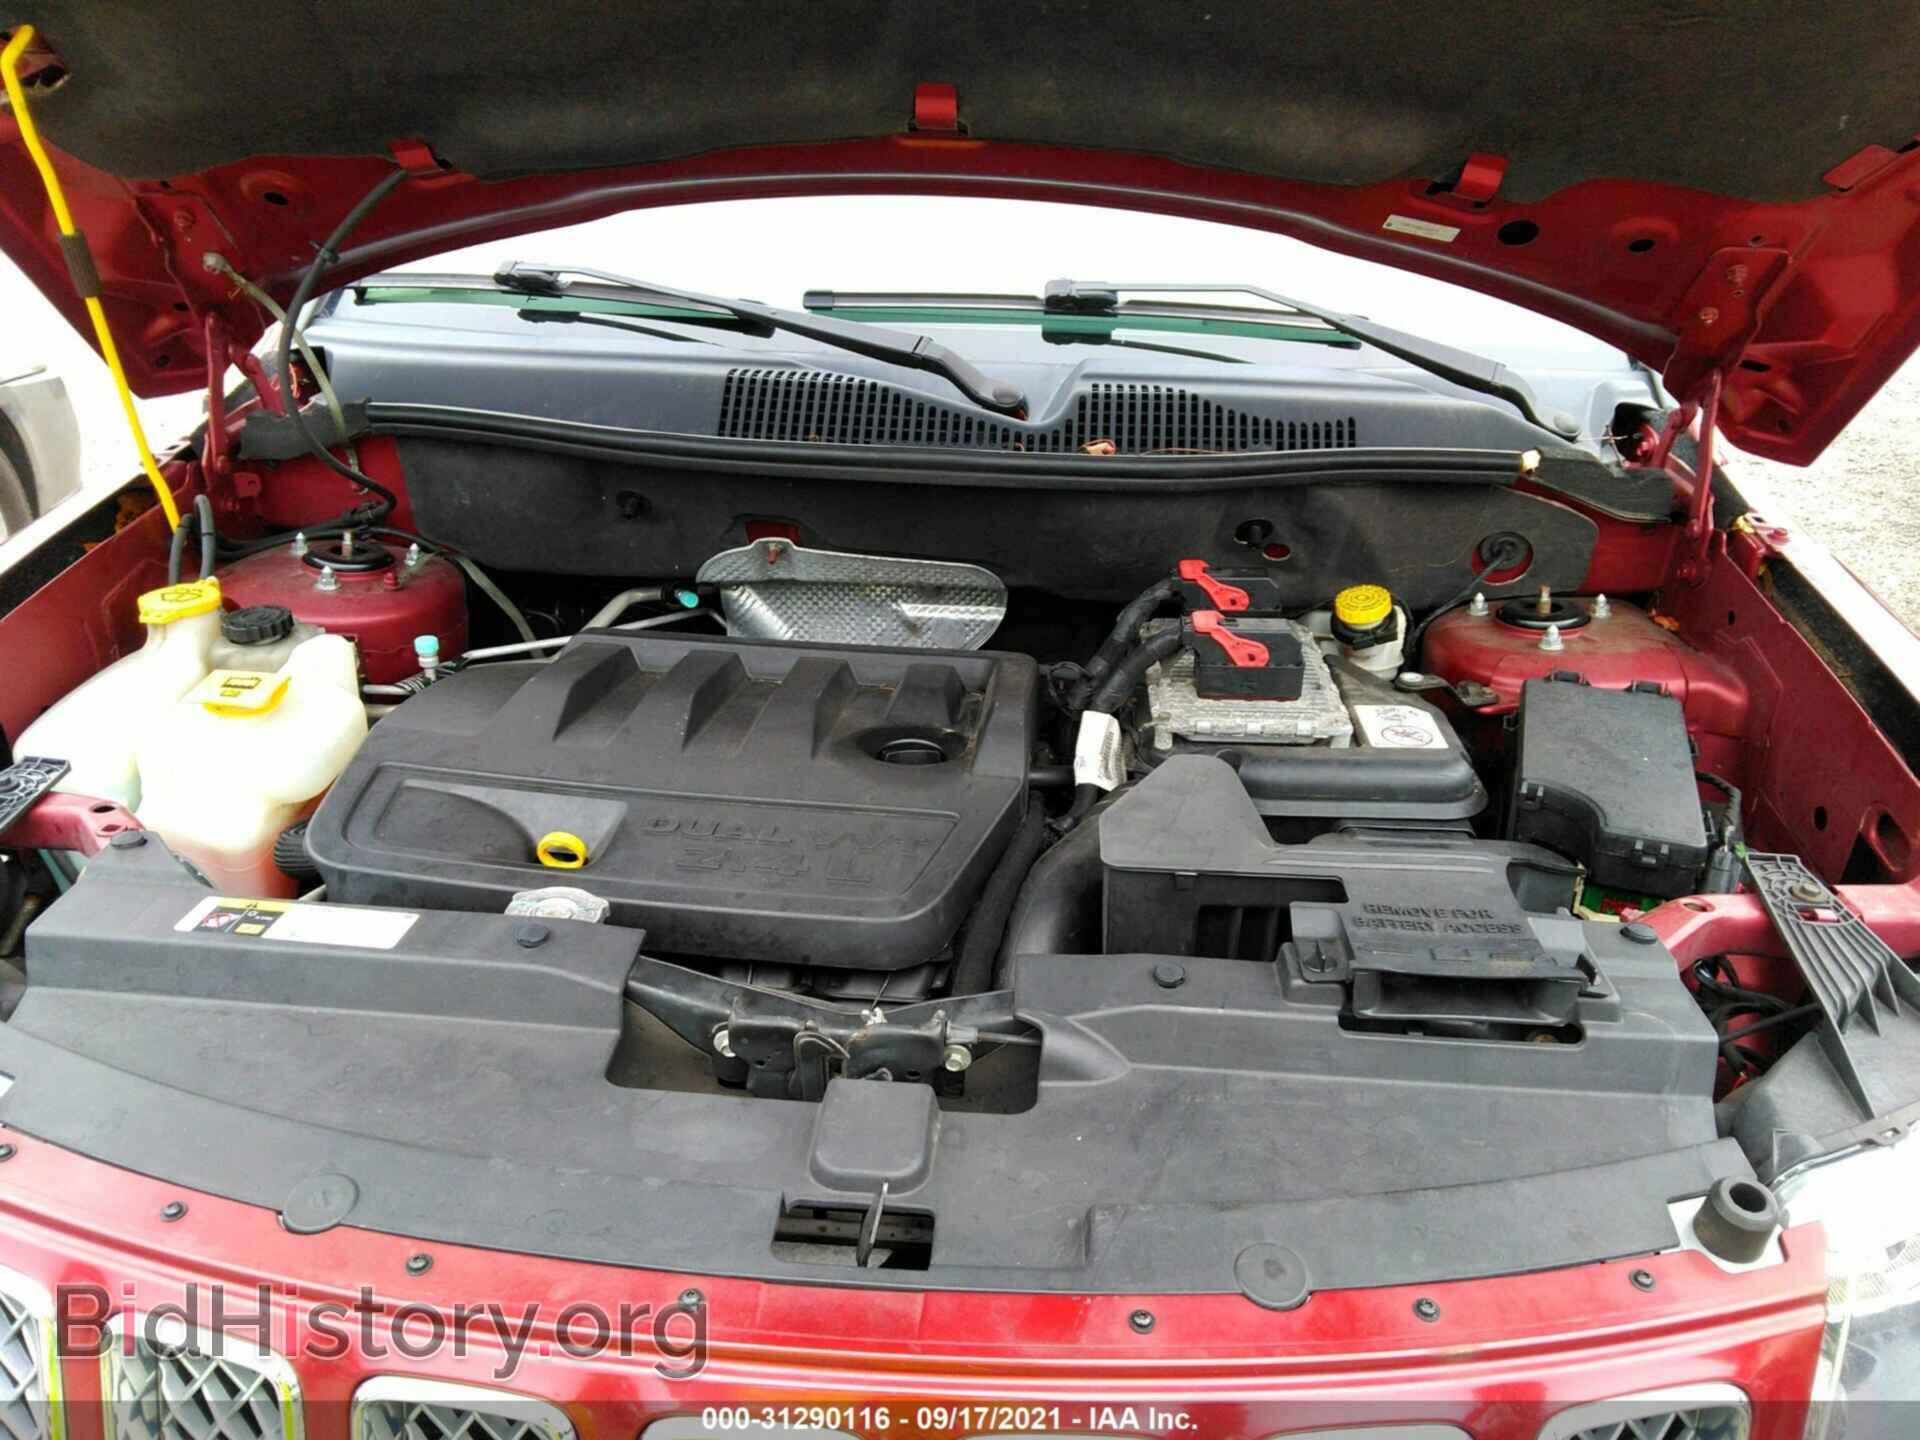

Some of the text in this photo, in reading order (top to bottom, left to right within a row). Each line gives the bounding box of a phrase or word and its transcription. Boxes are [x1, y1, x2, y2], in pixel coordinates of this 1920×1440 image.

[1362, 902, 1494, 920] REMOVE FOR
[1352, 916, 1523, 935] BATTERY ACCESS
